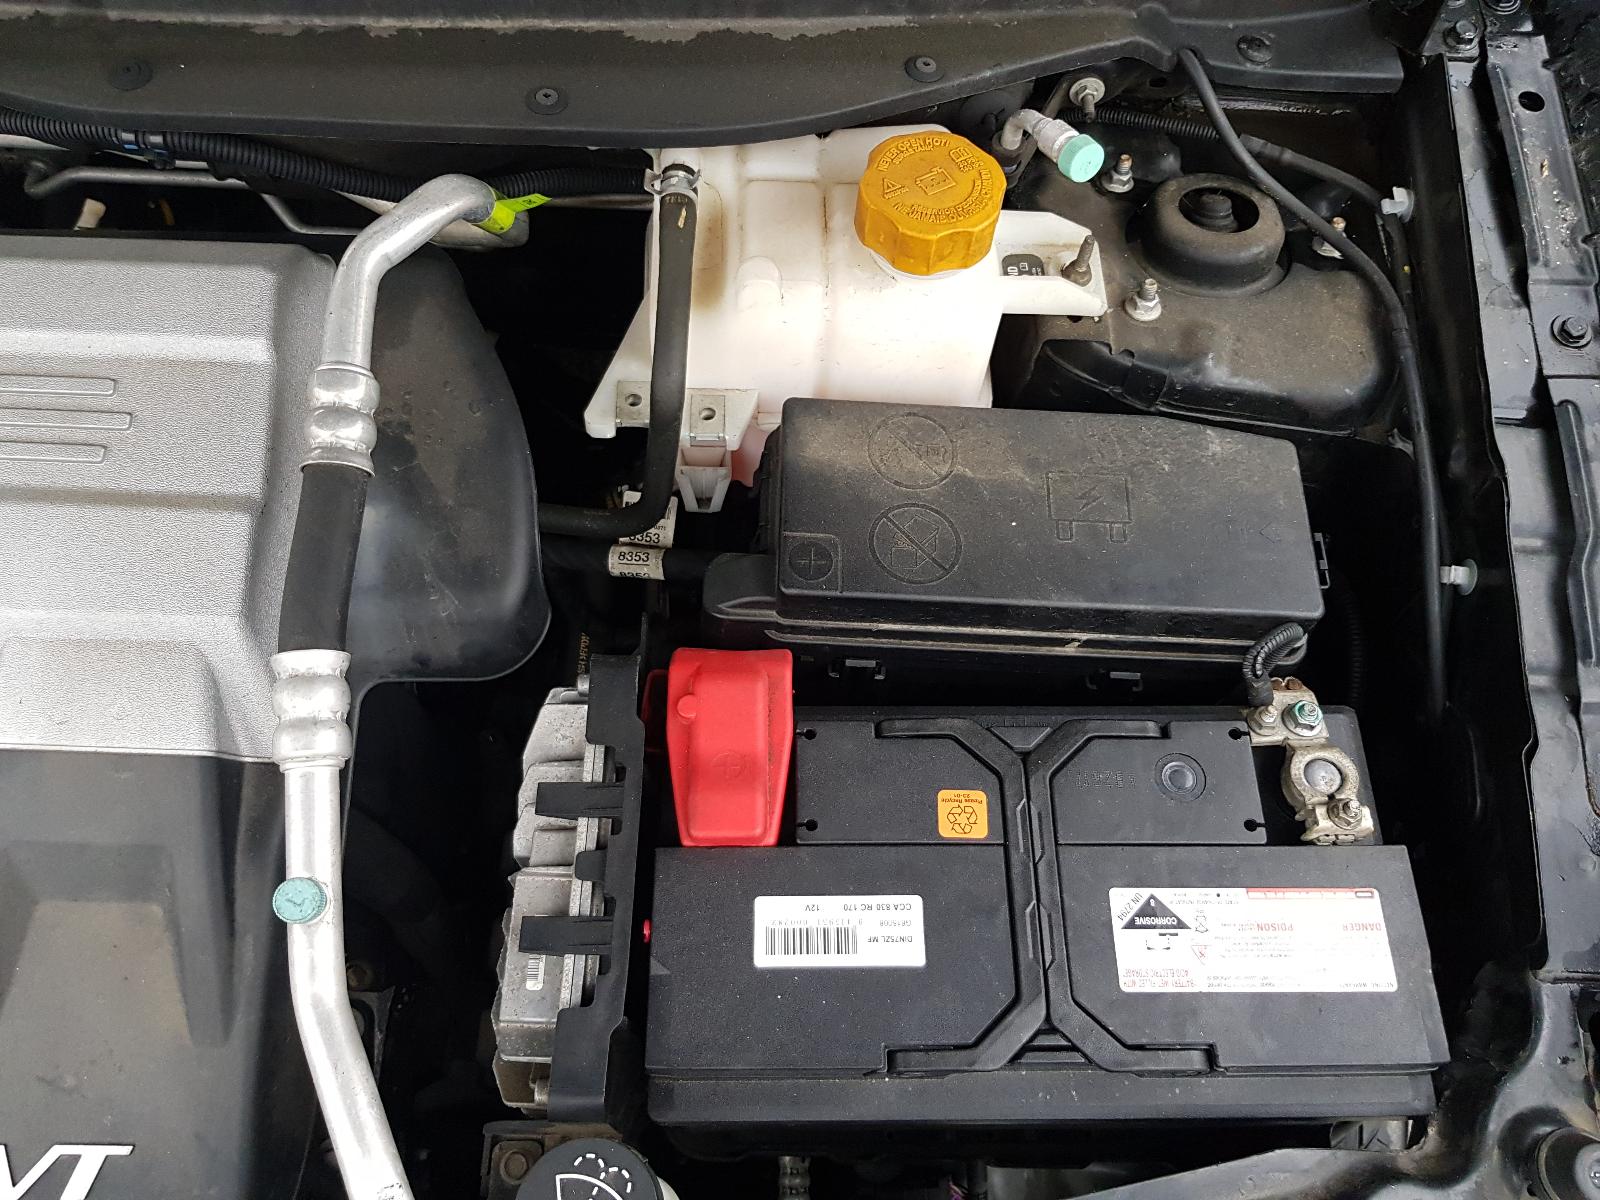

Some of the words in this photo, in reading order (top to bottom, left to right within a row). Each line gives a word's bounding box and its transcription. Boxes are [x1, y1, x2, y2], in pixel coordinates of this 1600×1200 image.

[877, 147, 900, 172] NEVER
[897, 138, 924, 151] OPEN
[618, 551, 650, 563] 8353
[941, 796, 963, 804] Recycle
[1130, 892, 1144, 905] UN
[805, 904, 820, 912] 12V
[843, 903, 858, 911] 170
[860, 903, 873, 911] RC
[877, 903, 891, 911] 830
[893, 903, 912, 911] CCA
[1117, 902, 1134, 921] 2794
[1134, 916, 1178, 925] CORROSIVE
[1256, 922, 1294, 931] POISON
[1343, 922, 1382, 931] DANGER
[867, 935, 880, 943] MF
